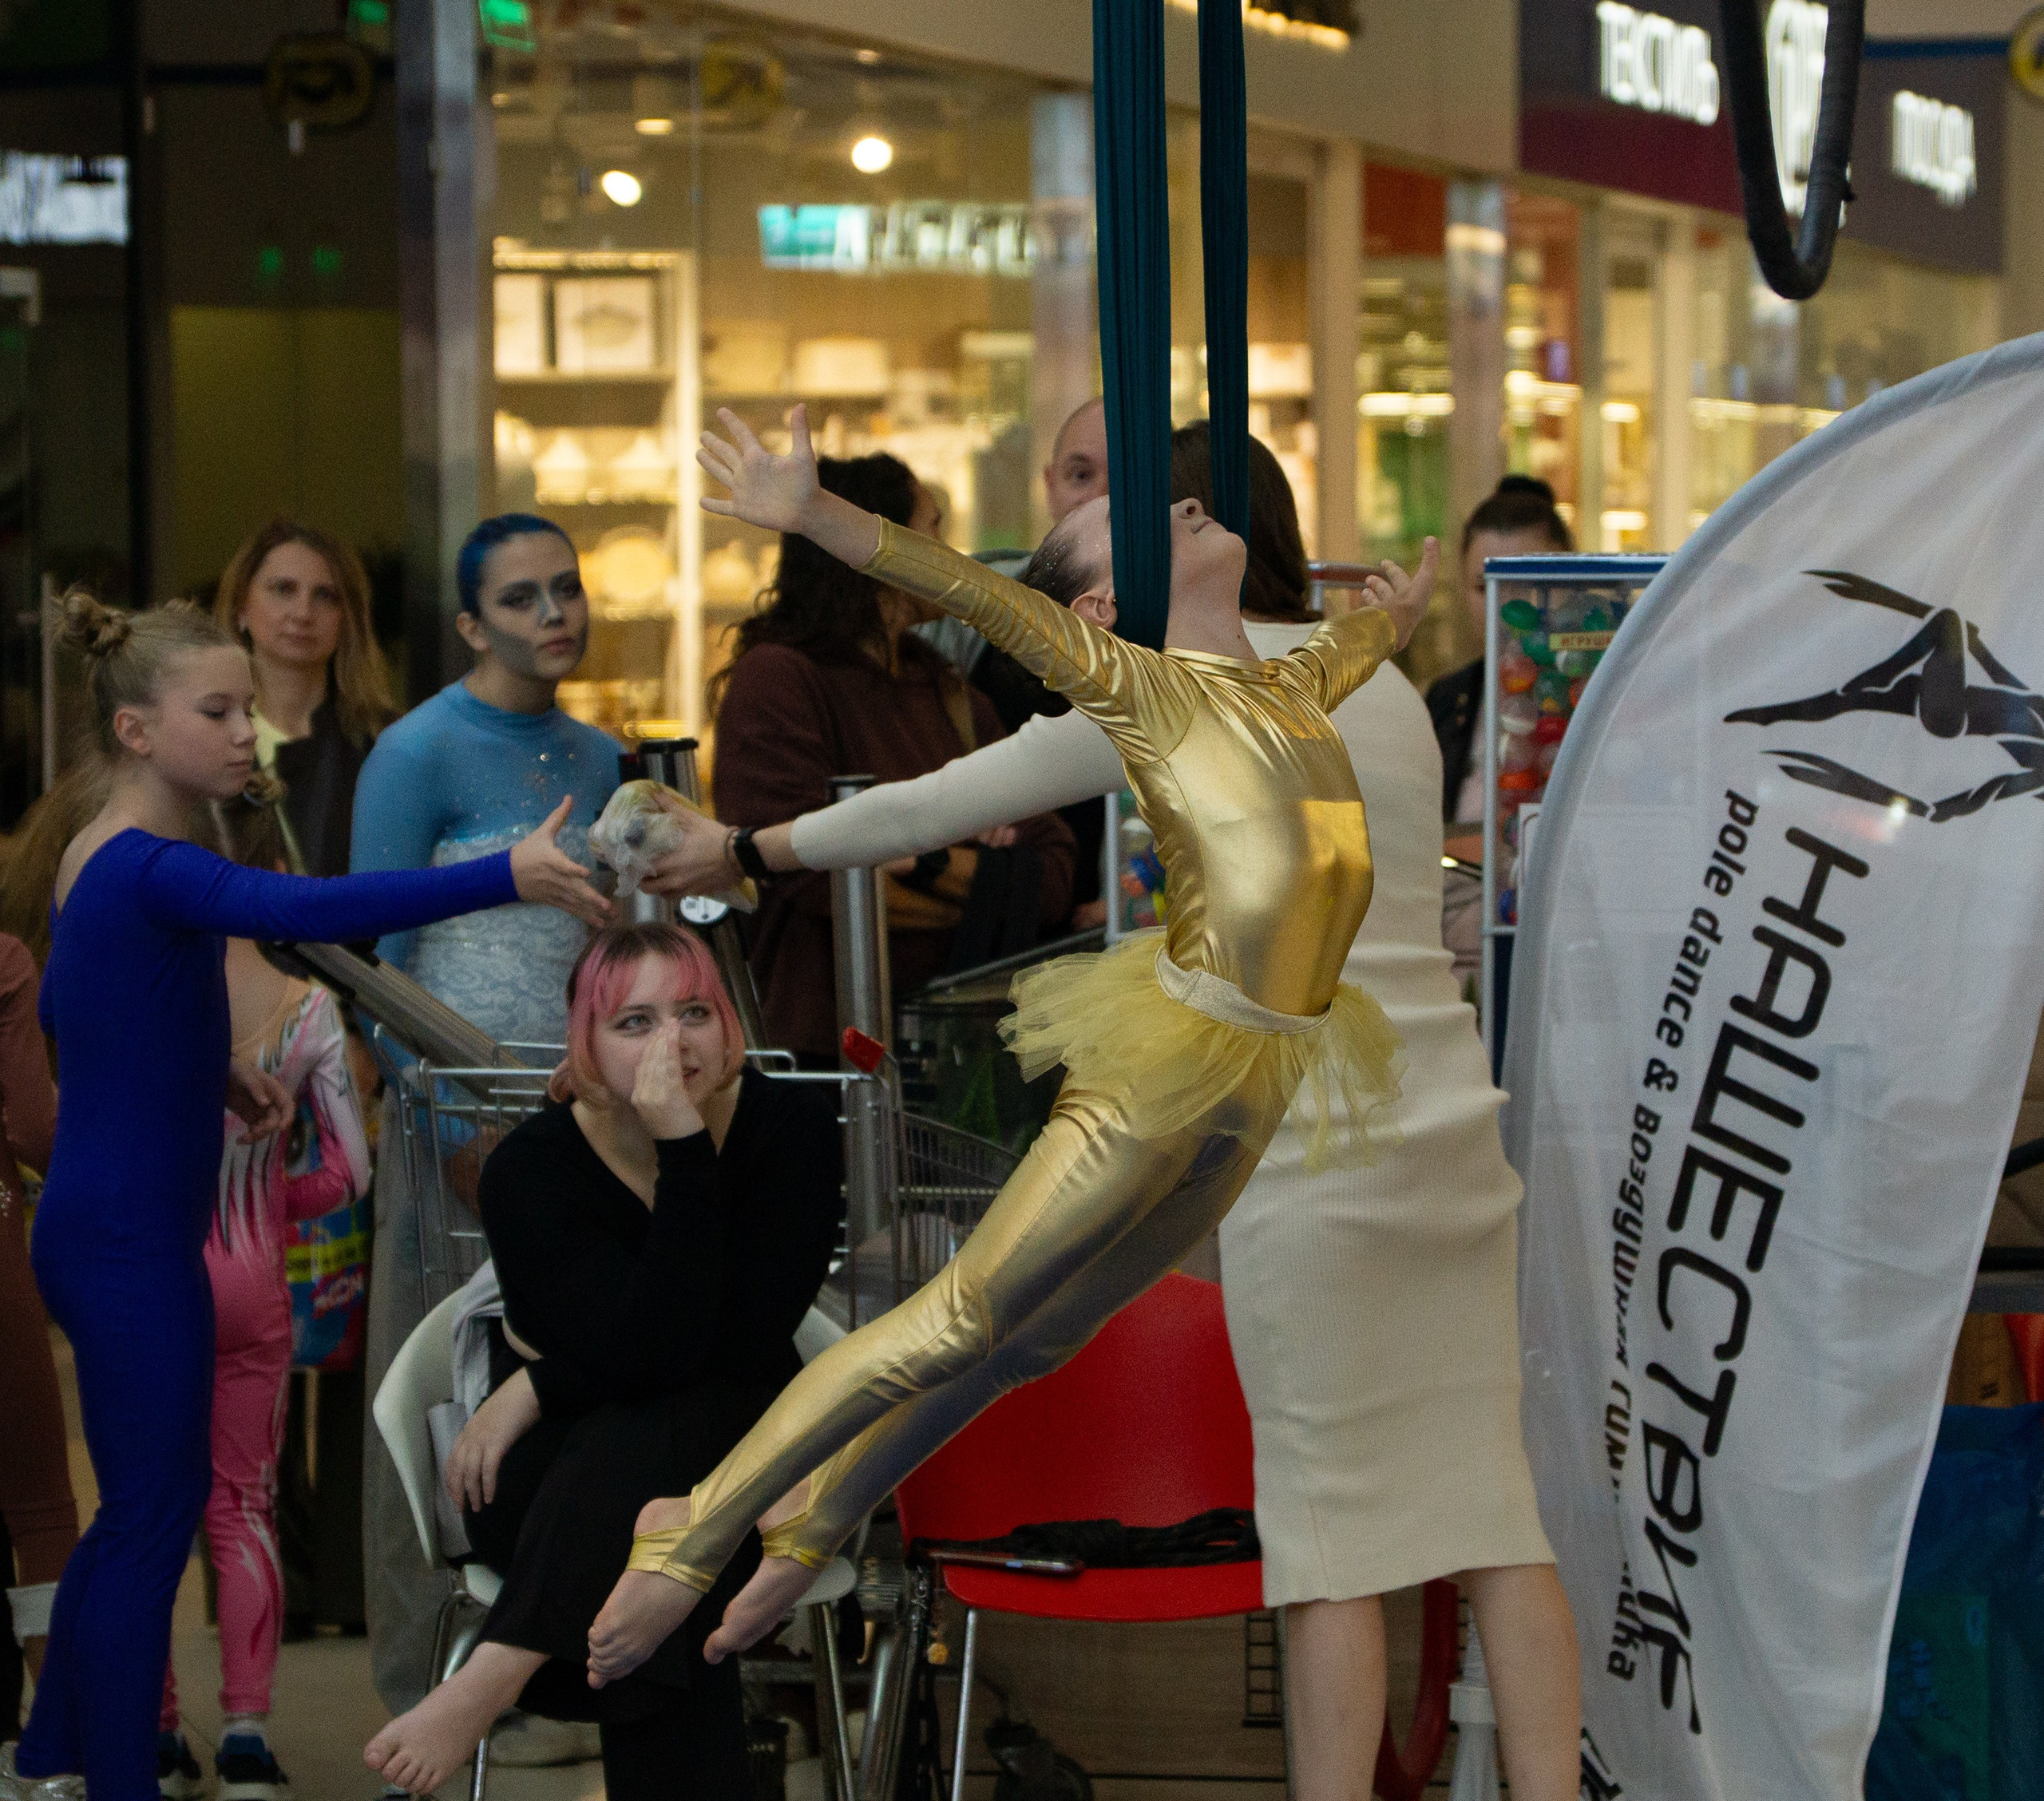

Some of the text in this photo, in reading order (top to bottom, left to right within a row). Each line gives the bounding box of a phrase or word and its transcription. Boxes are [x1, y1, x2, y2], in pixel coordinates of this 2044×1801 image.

[1702, 789, 1760, 897] pole
[1655, 907, 1724, 1049] dance
[1643, 1057, 1679, 1092] &
